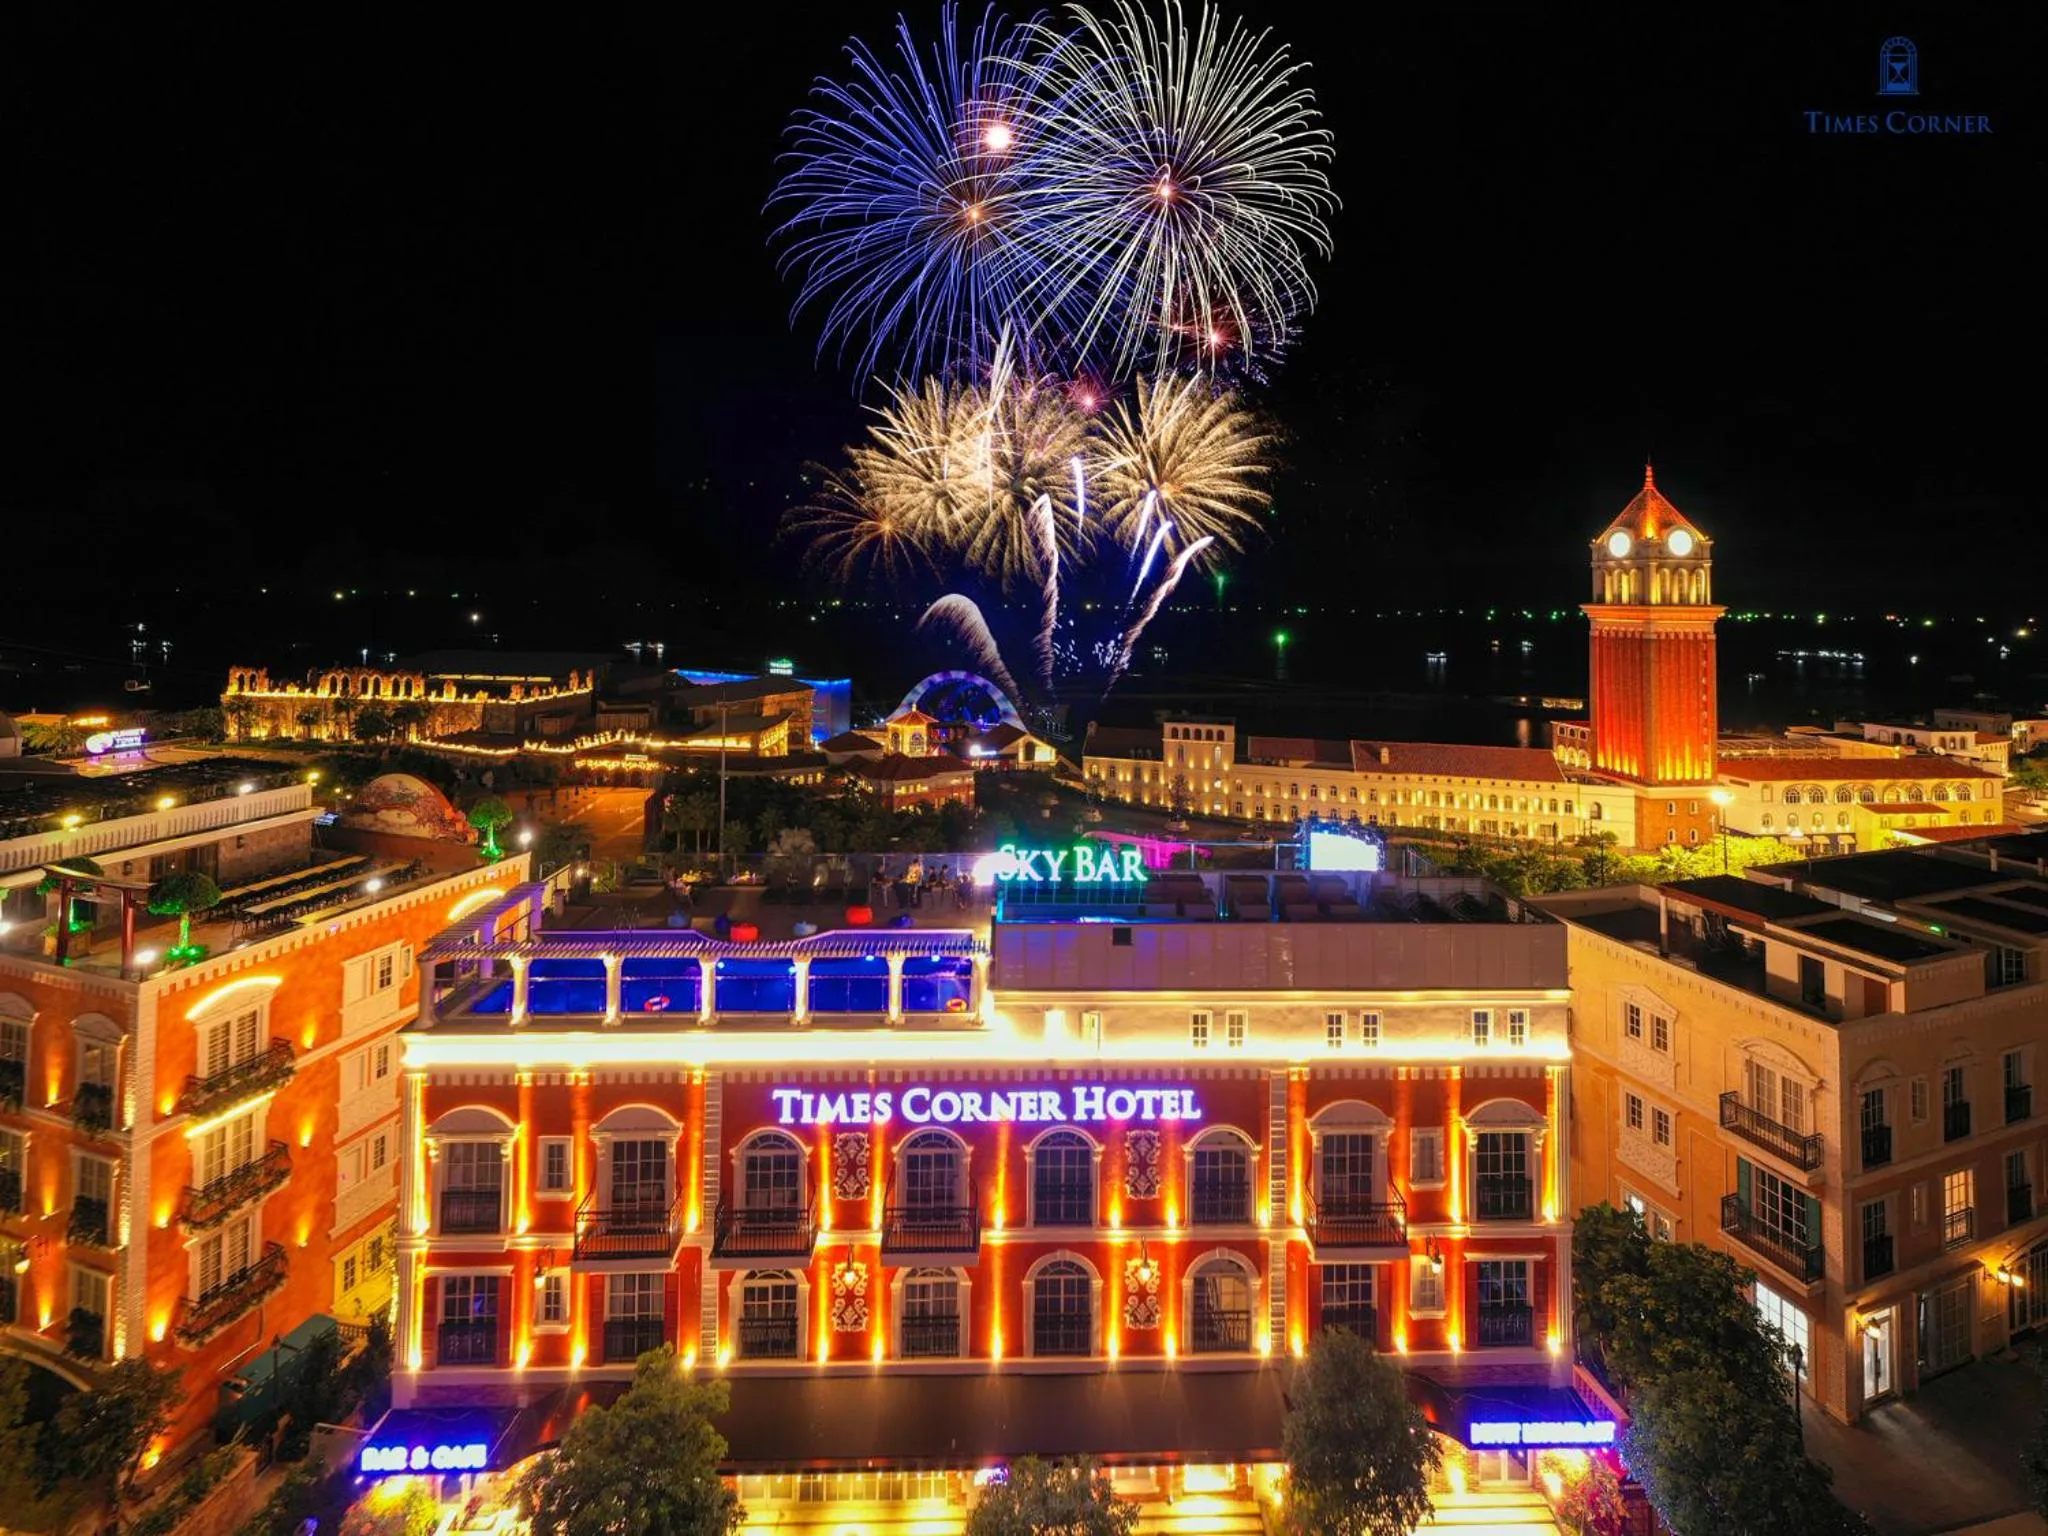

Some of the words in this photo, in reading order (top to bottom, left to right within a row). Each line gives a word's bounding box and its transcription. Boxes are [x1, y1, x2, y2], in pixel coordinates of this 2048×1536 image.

[998, 844, 1068, 882] SKY
[1074, 846, 1148, 882] BAR
[772, 1087, 892, 1124] TIMES
[902, 1087, 1067, 1122] CORNER
[1073, 1086, 1202, 1121] HOTEL
